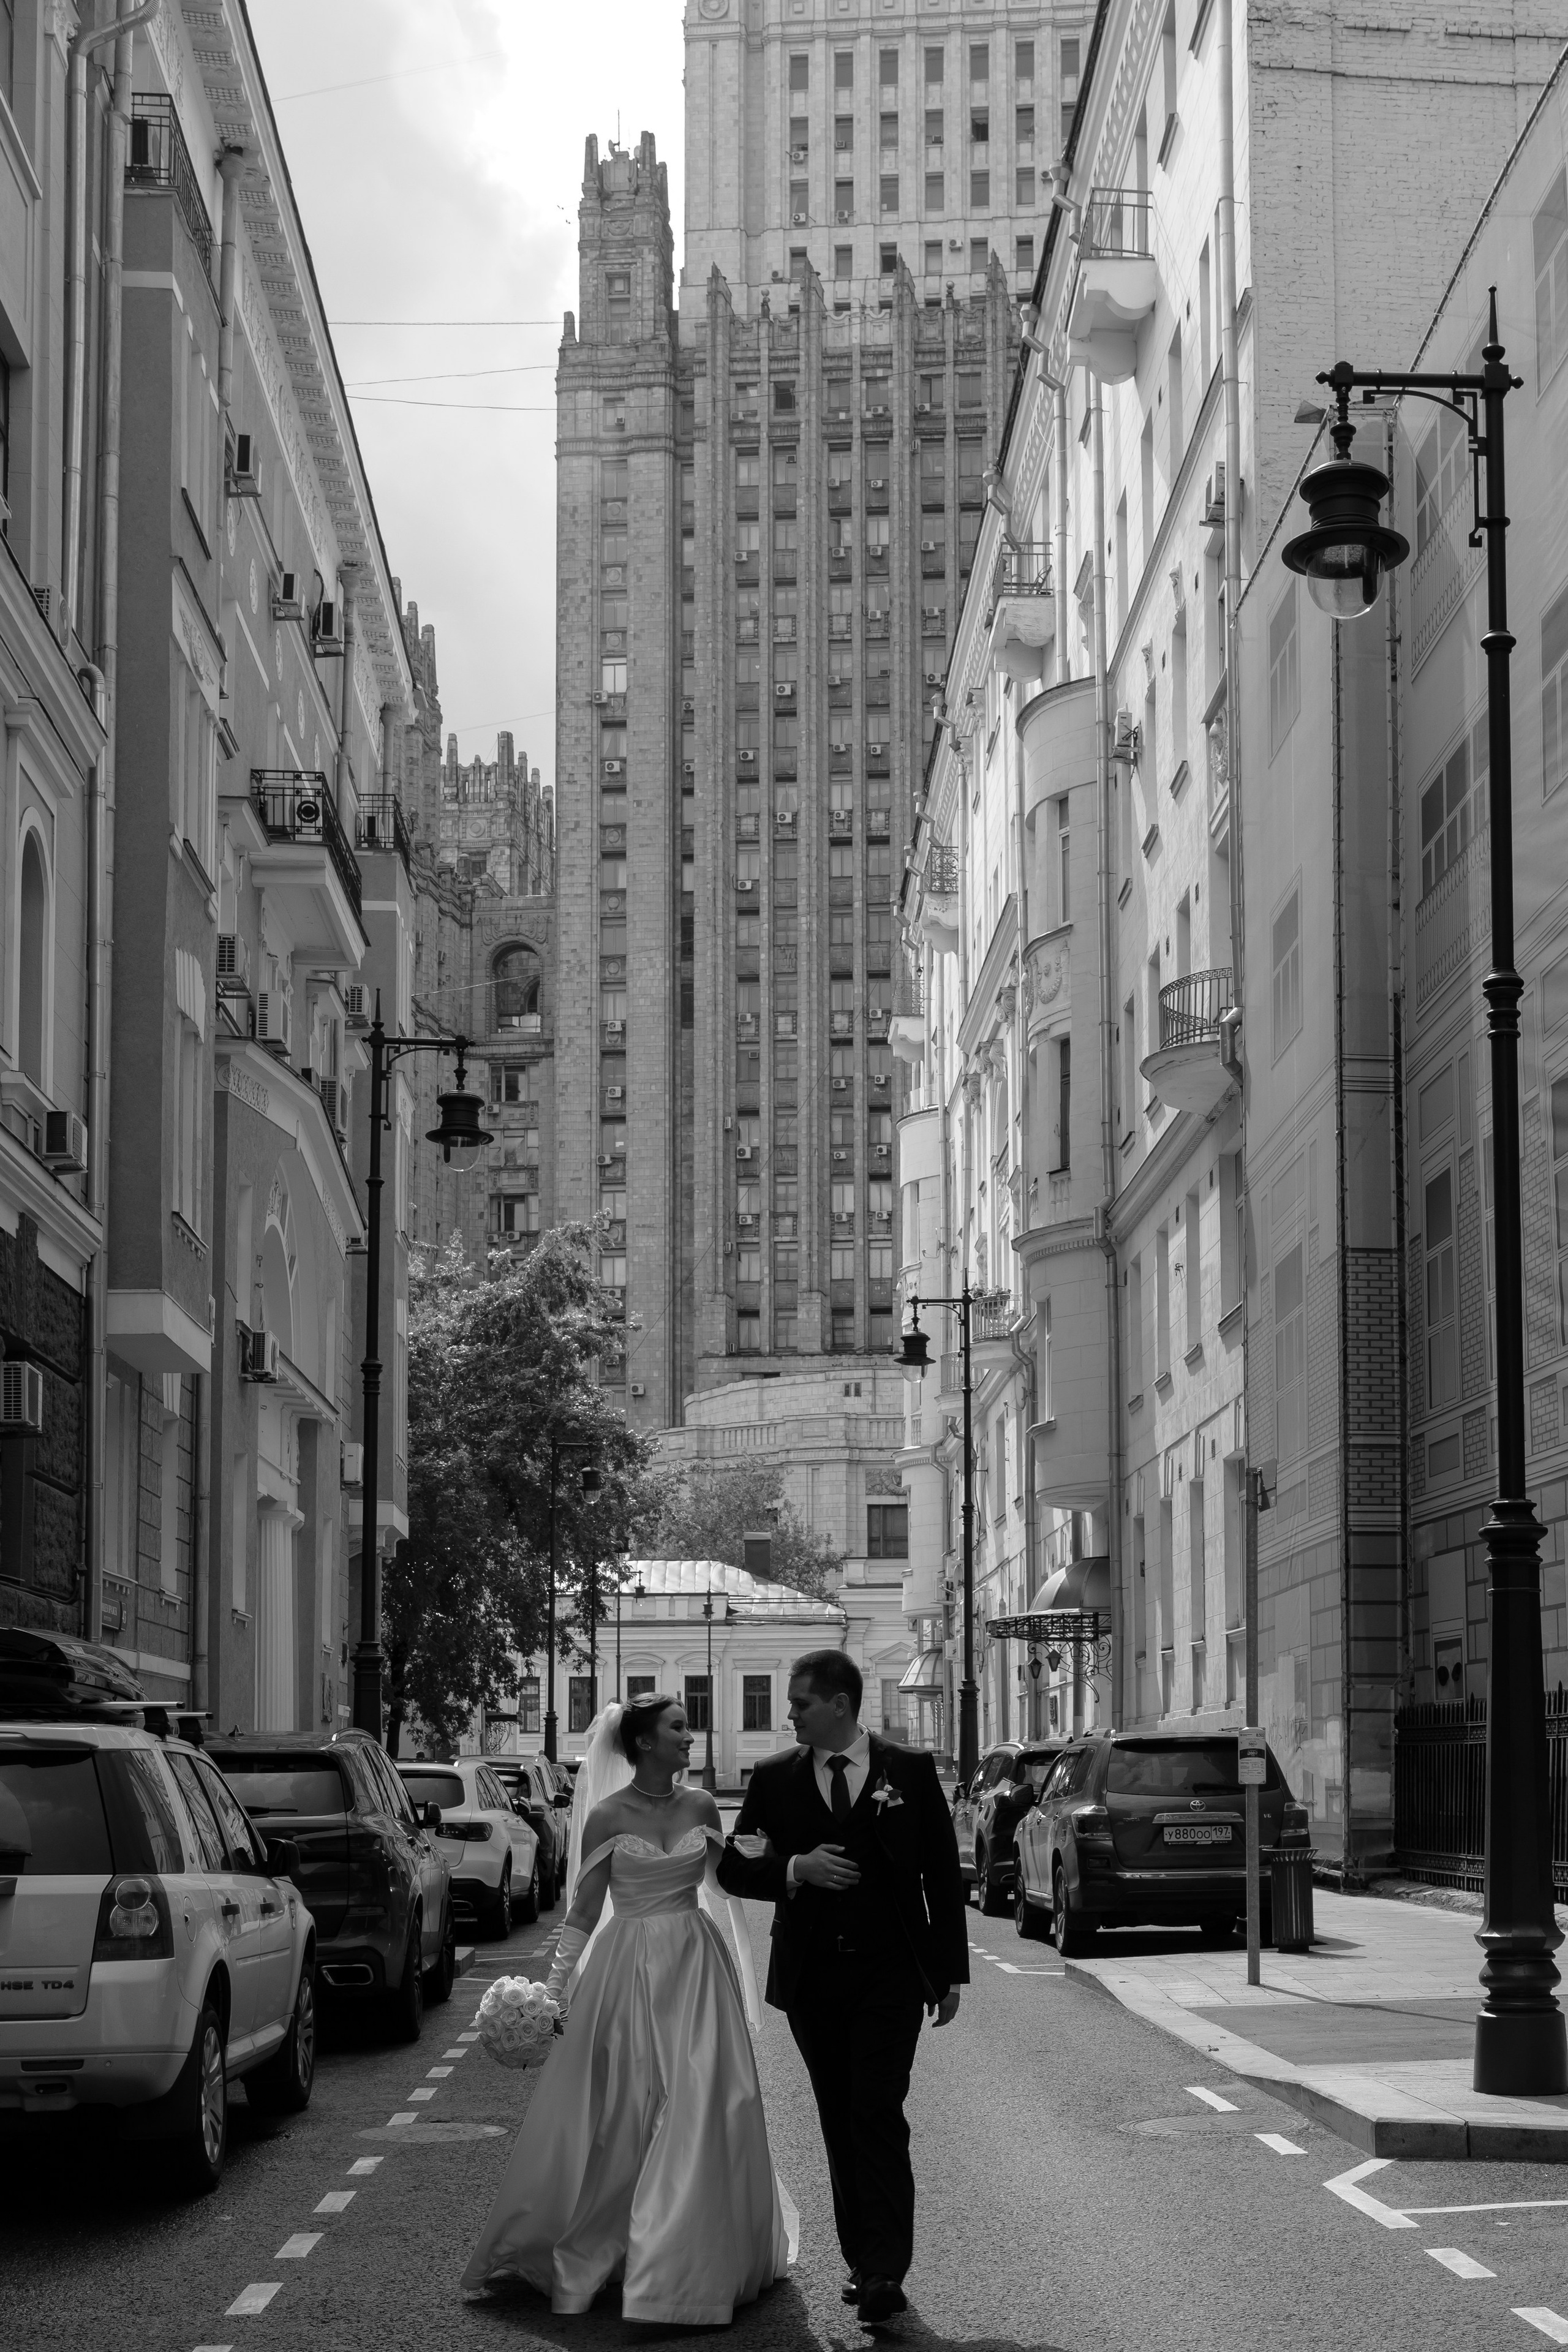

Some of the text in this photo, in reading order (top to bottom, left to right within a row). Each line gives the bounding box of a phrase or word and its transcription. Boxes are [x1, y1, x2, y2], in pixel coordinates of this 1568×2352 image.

[1213, 1827, 1228, 1836] 197
[1, 1980, 74, 1990] HSE TD4
